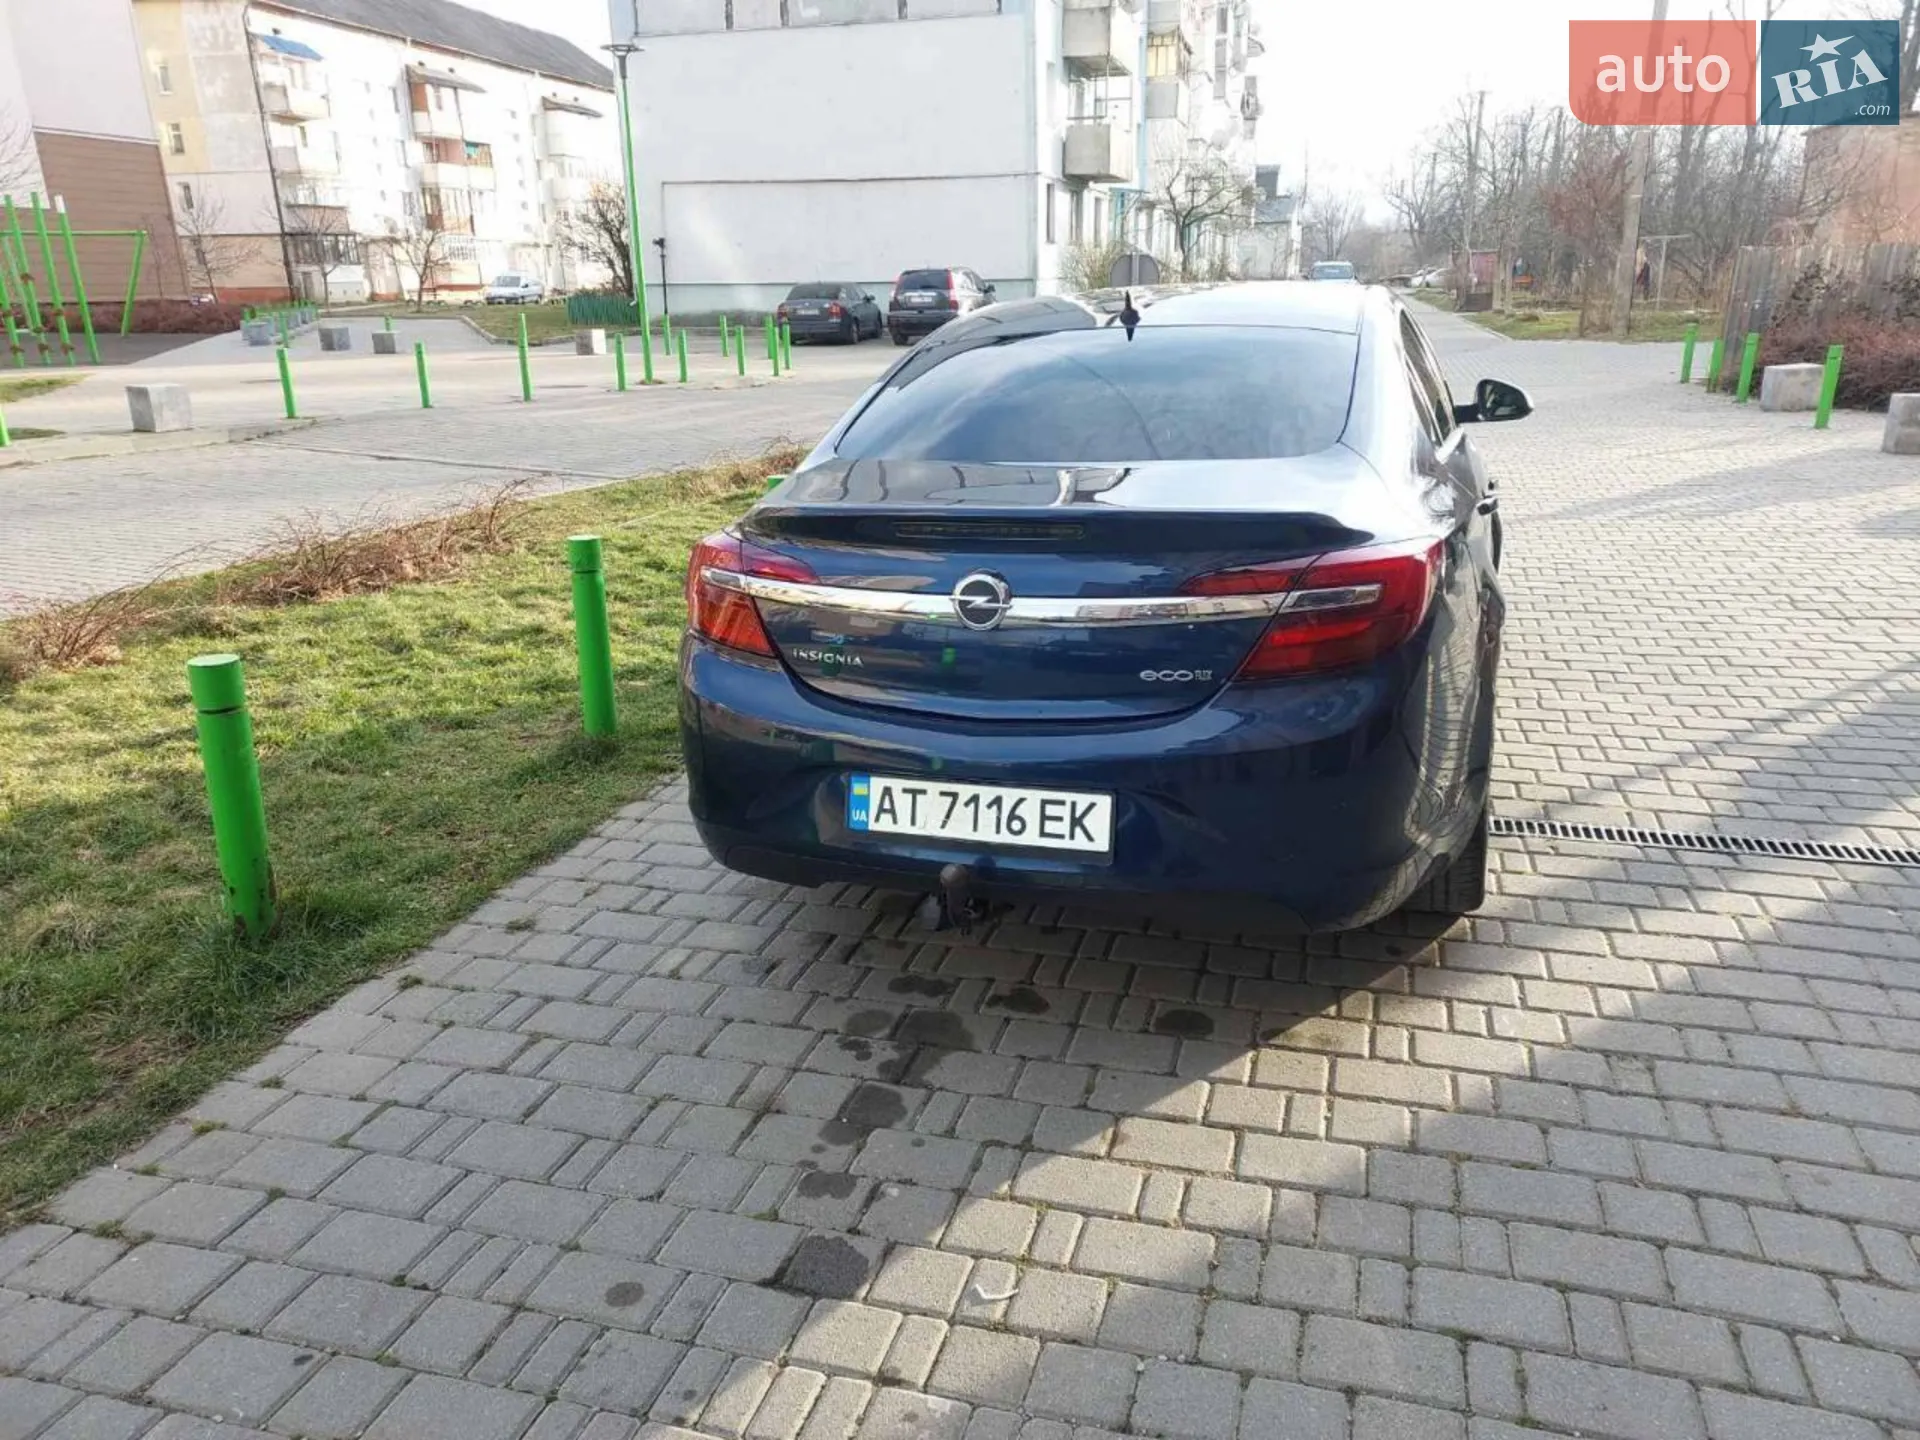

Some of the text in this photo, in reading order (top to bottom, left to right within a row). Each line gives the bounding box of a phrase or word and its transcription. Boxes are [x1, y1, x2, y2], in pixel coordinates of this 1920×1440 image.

[792, 647, 864, 668] INSIGNIA
[852, 810, 868, 823] UA
[874, 786, 1098, 843] AT 7116 EK
